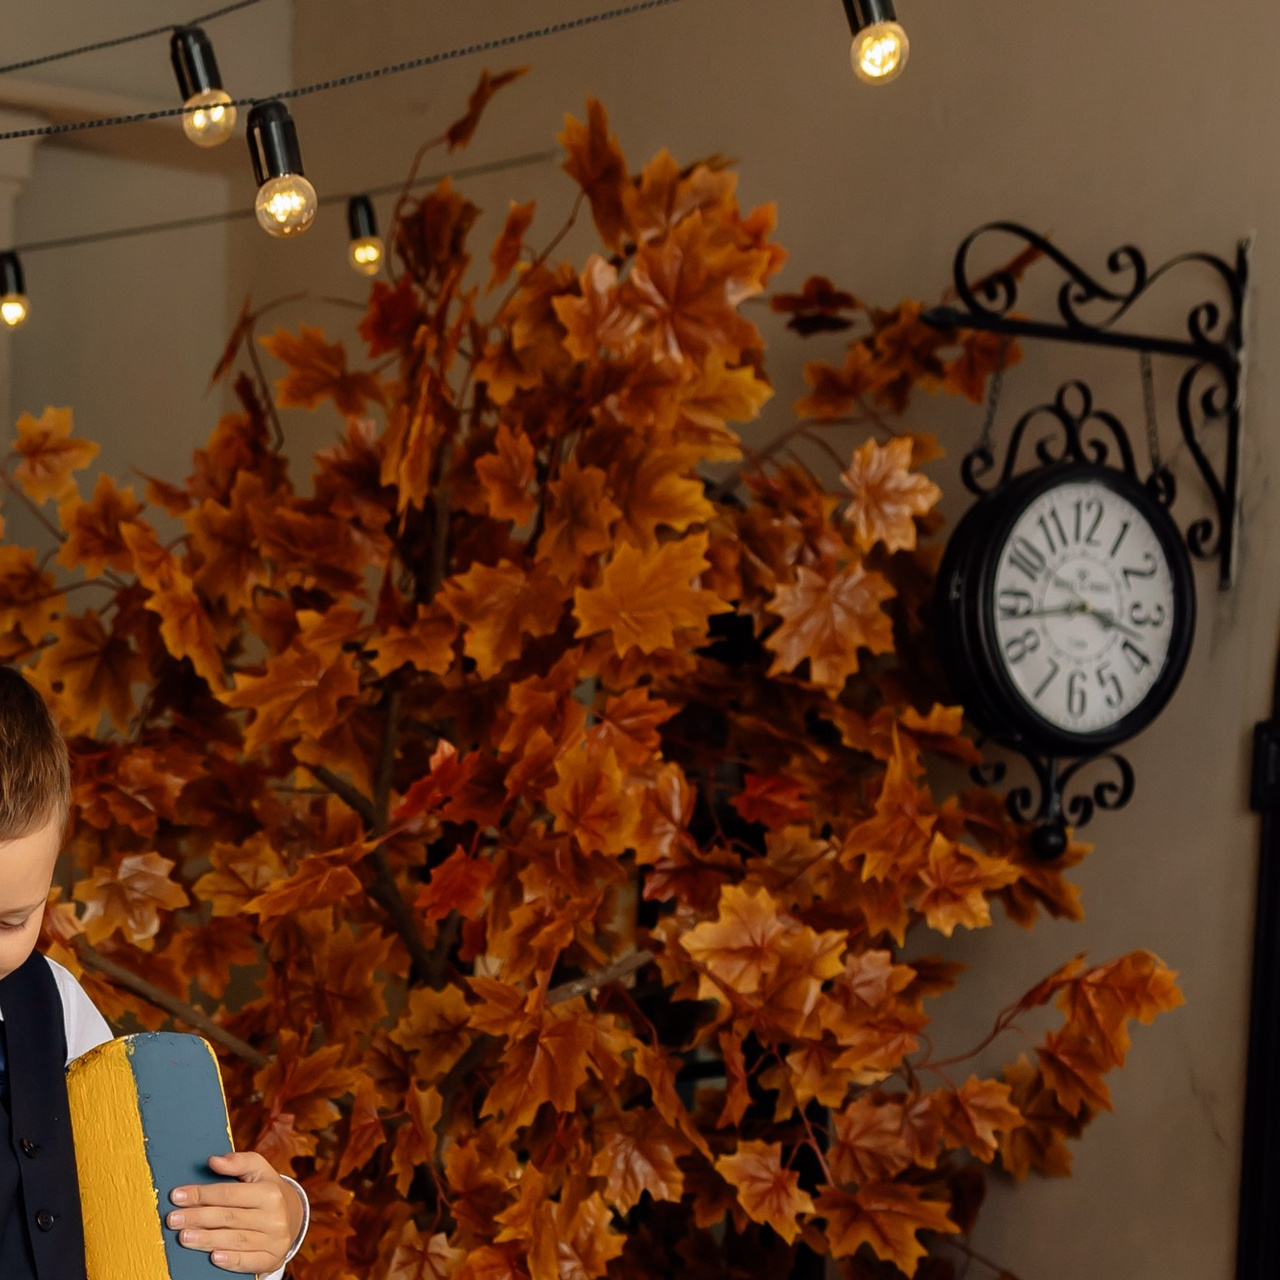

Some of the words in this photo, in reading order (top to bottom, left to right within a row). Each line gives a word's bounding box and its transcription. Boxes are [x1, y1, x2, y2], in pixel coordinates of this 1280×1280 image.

[1038, 505, 1068, 556] 11
[1073, 498, 1104, 546] 12
[1110, 520, 1131, 558] 1
[1008, 535, 1047, 583] 10
[1122, 552, 1158, 592] 2
[1129, 601, 1165, 629] 3
[1004, 628, 1041, 664] 8
[1121, 639, 1151, 676] 4
[1033, 656, 1060, 700] 7
[1067, 669, 1087, 719] 6
[1096, 660, 1123, 709] 5
